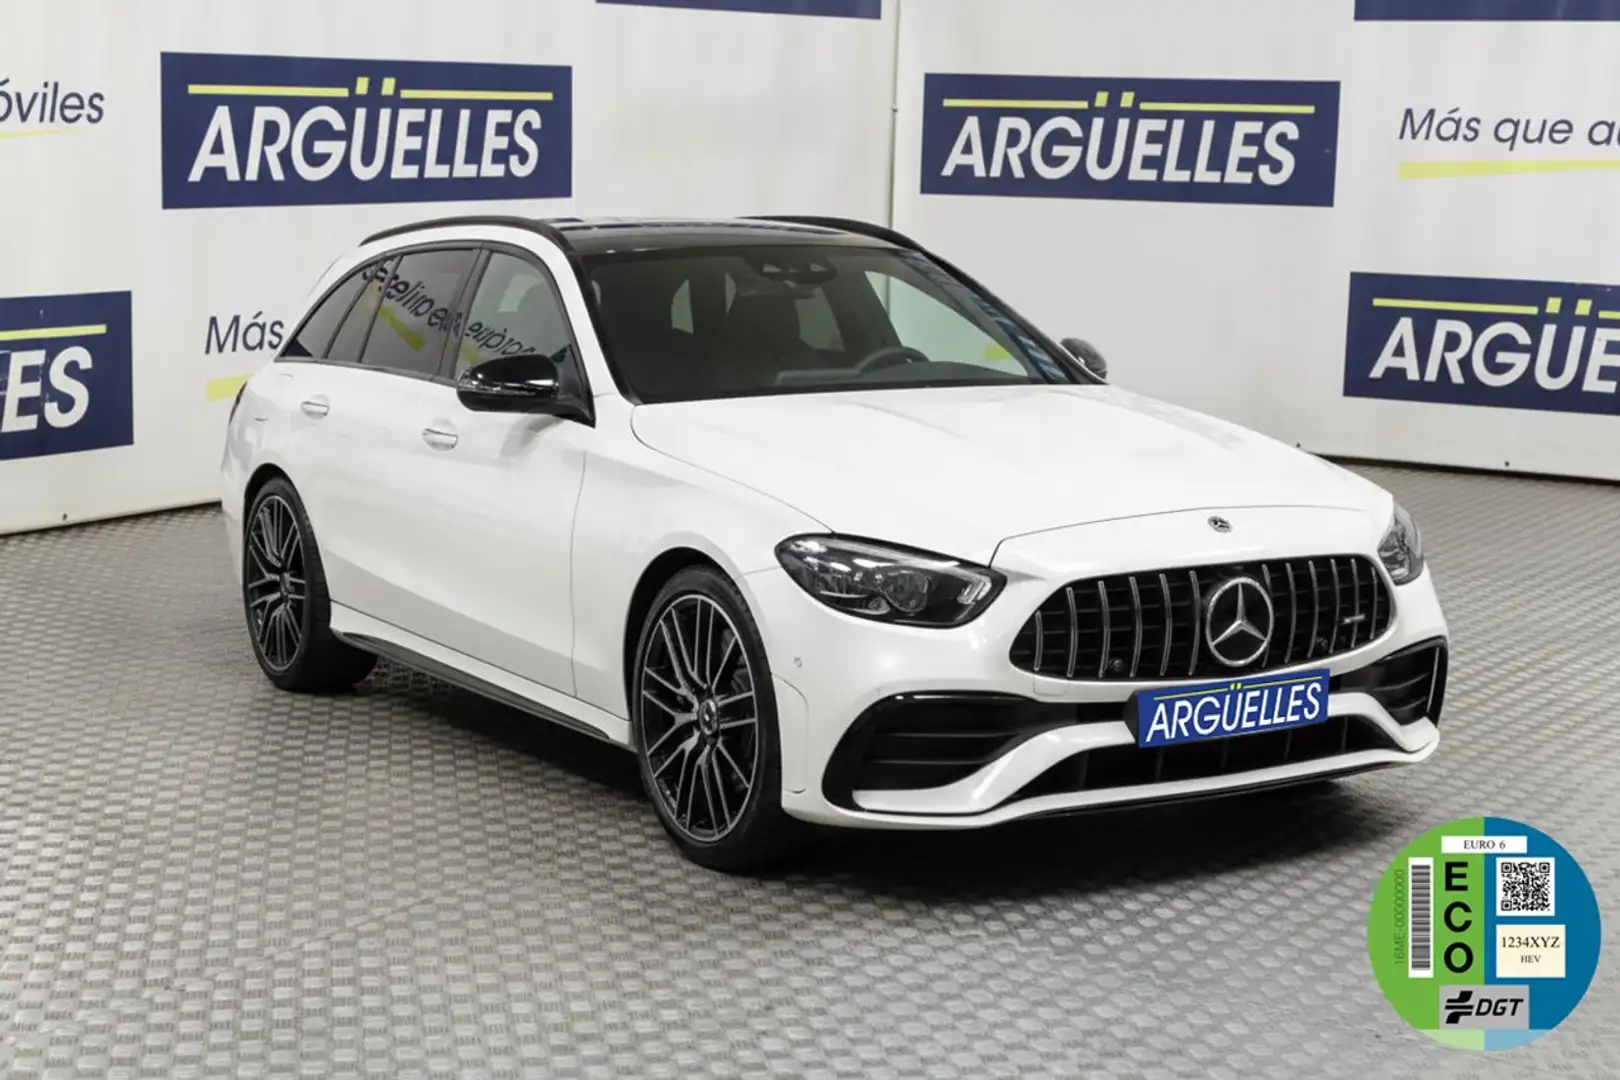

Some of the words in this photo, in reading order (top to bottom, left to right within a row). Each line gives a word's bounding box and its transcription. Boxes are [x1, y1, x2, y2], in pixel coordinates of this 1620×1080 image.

[187, 77, 542, 182] ARGÜELLES
[941, 92, 1300, 186] ARGÜELLES
[1399, 107, 1481, 142] Más
[1493, 117, 1574, 151] que
[1587, 120, 1620, 145] a
[204, 310, 285, 355] Más
[1146, 682, 1321, 742] ARGÜELLES
